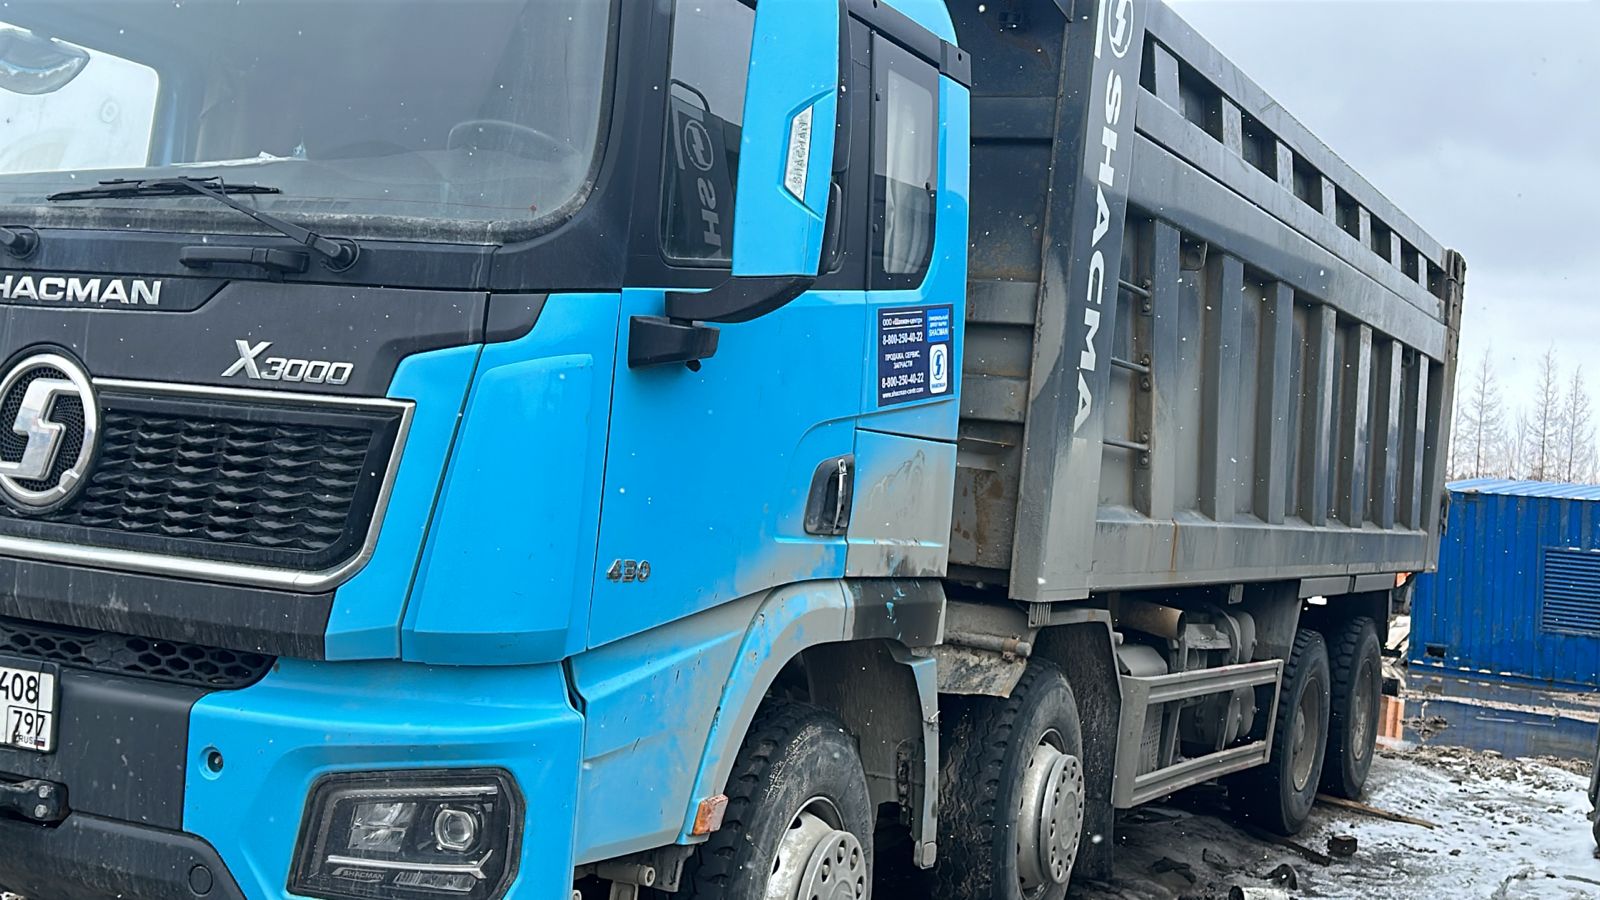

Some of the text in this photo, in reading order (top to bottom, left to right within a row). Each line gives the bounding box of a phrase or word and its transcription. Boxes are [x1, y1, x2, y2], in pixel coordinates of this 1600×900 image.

[1072, 69, 1122, 452] SHACMA
[882, 318, 893, 327] ООО
[882, 332, 923, 345] 8-800-250-40-22
[221, 338, 354, 385] X3000
[881, 373, 924, 388] 8-800-250-40-22
[606, 558, 651, 582] 430
[0, 671, 38, 704] 408
[13, 710, 46, 737] 797
[17, 734, 34, 745] RUS
